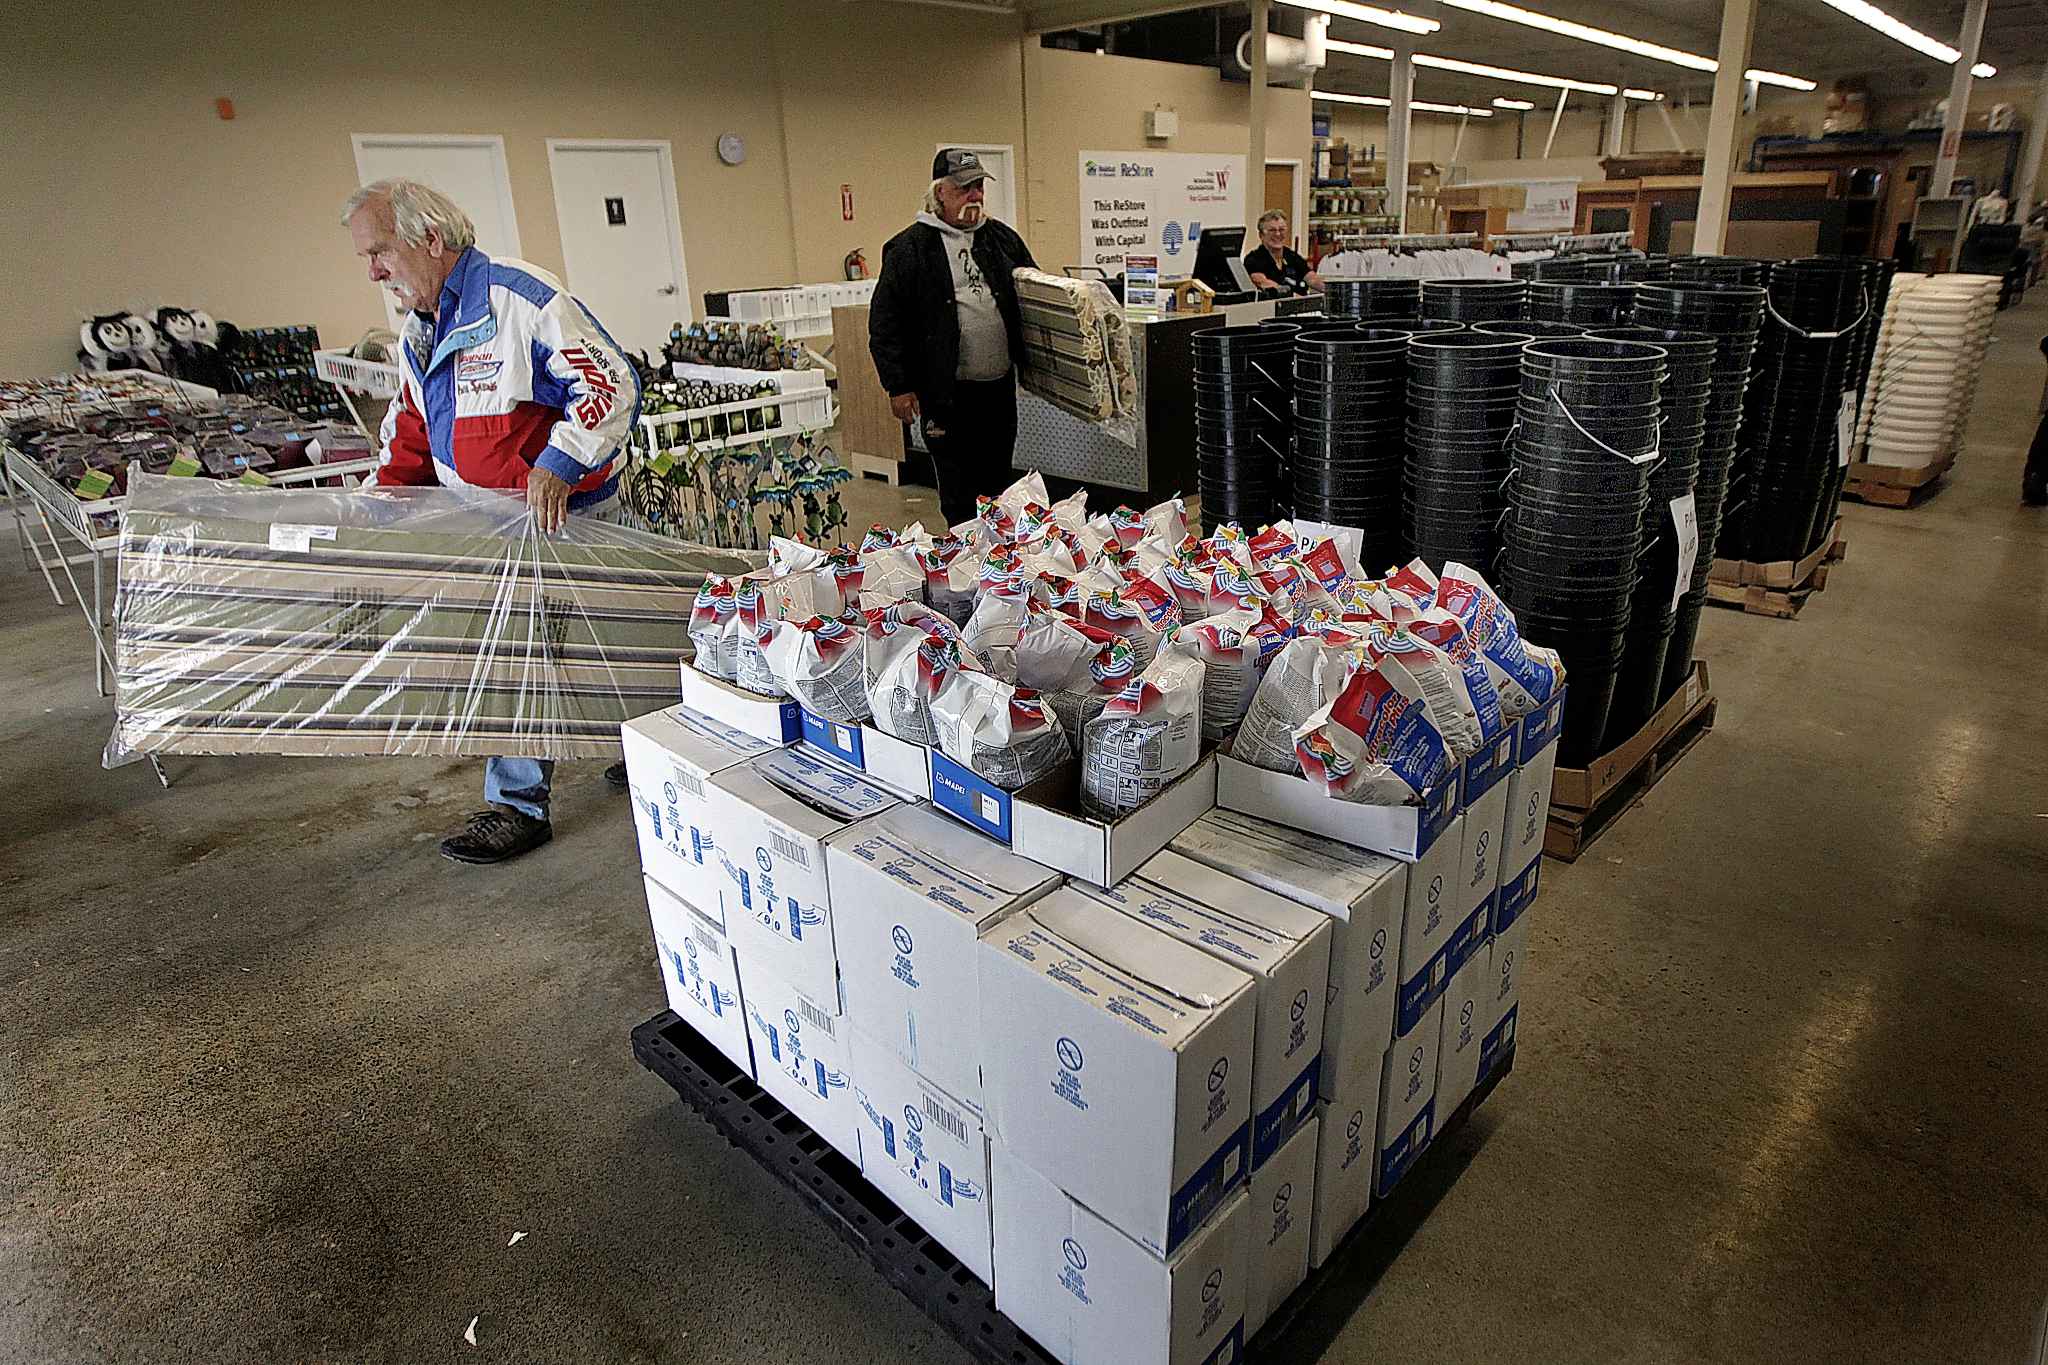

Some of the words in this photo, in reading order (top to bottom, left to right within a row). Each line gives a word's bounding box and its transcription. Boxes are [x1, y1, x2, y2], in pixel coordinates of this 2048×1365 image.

[1121, 163, 1154, 177] ReStore
[1094, 200, 1112, 211] This
[1113, 200, 1146, 211] ReStore
[1092, 219, 1109, 230] Was
[1111, 216, 1149, 229] Outfitted
[1095, 234, 1116, 247] With
[1116, 233, 1146, 247] Capital
[1095, 252, 1124, 265] Grants
[1152, 601, 1178, 633] ltracolor
[1366, 691, 1398, 765] Ultracolor
[944, 778, 966, 796] MAPEI
